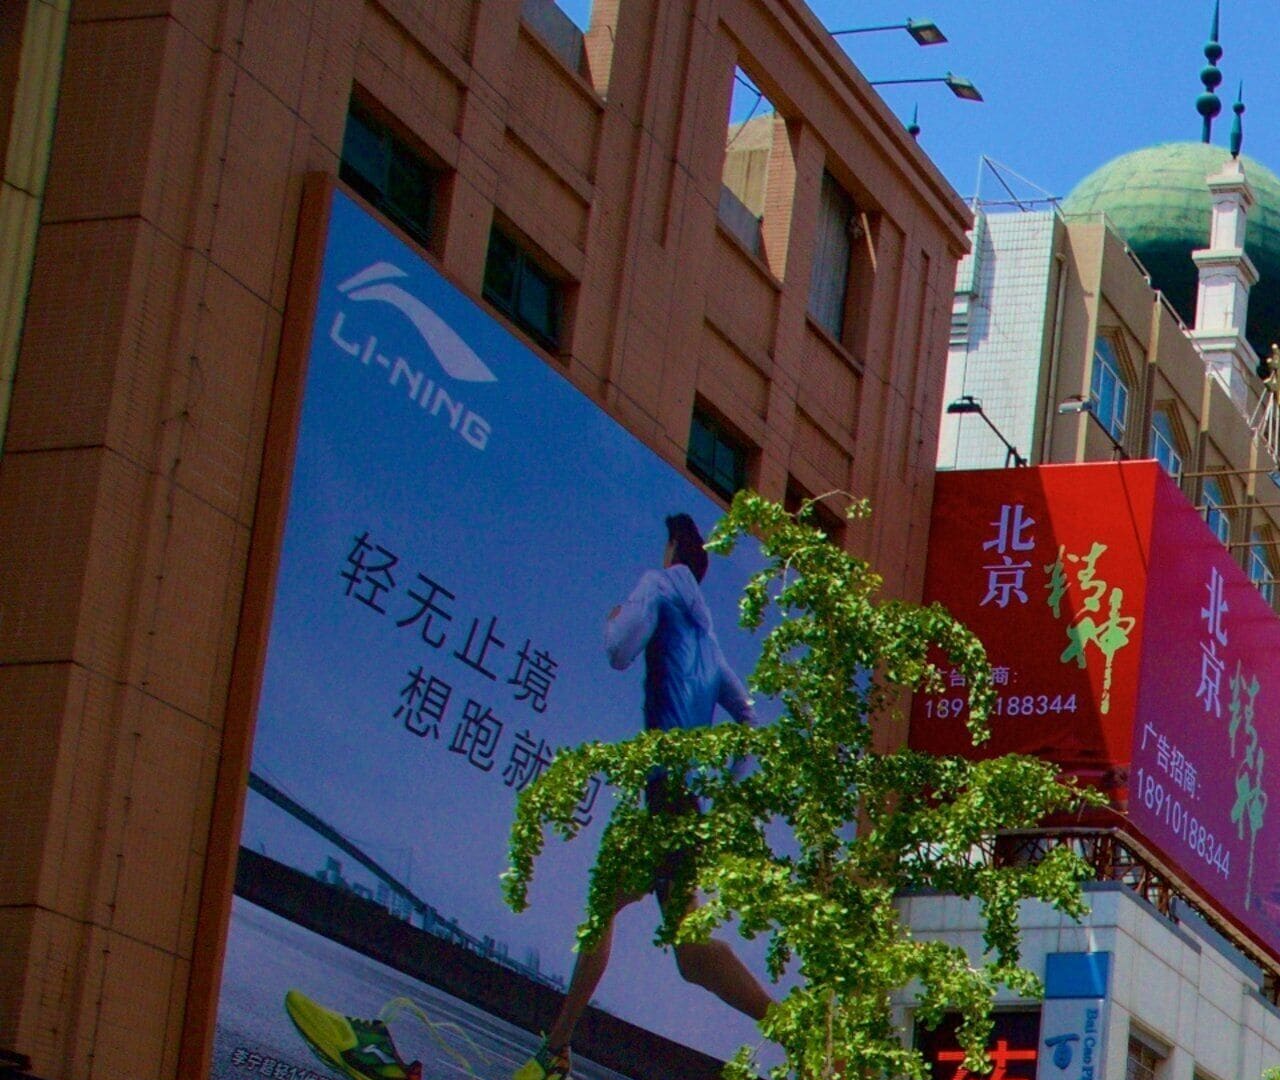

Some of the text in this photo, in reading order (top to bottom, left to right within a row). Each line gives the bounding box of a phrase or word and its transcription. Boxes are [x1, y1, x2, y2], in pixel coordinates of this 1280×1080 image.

[330, 312, 492, 451] LI-NING
[979, 504, 1036, 608] 北京
[340, 531, 559, 714] 轻无止境
[1196, 566, 1228, 718] 北京
[925, 694, 1077, 718] 189188344
[1137, 768, 1231, 880] 18910188344
[1081, 1037, 1096, 1064] Cao
[1084, 1008, 1098, 1033] Bai
